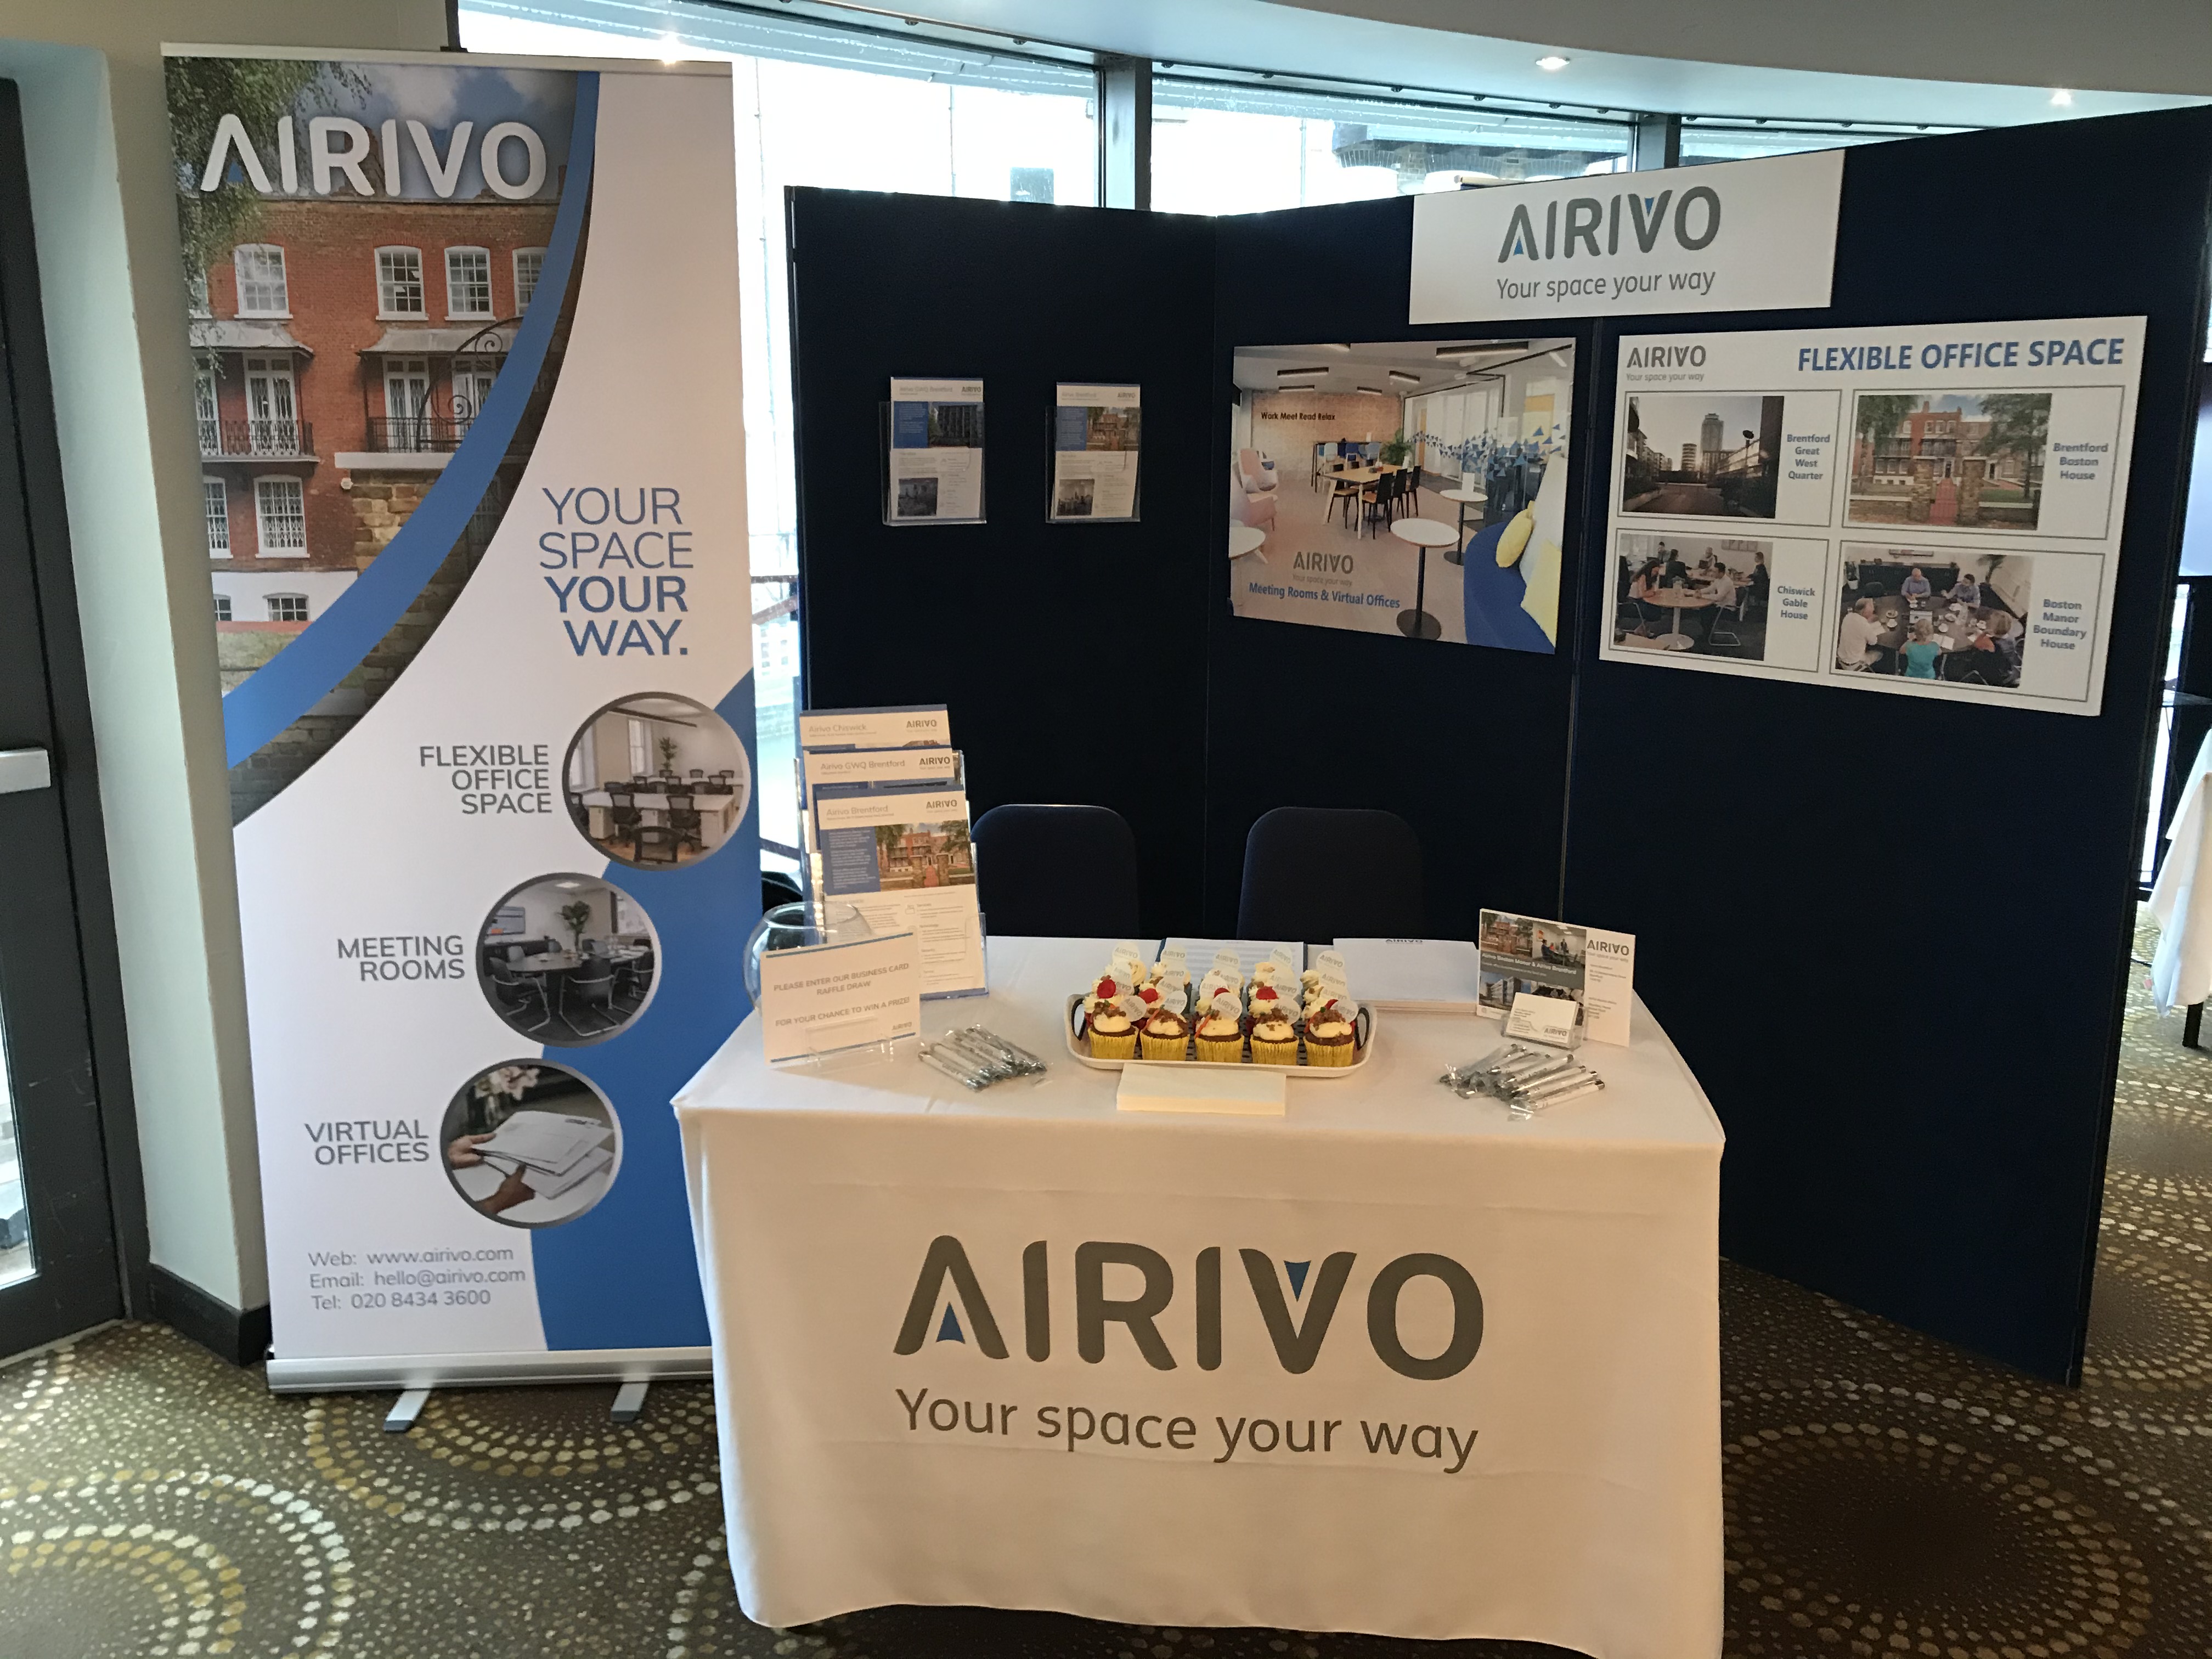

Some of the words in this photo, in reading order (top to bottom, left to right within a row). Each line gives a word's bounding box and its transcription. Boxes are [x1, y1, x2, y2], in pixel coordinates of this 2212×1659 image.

[200, 114, 547, 199] AIRIVO
[1498, 187, 1720, 263] AIRIVO
[1497, 278, 1539, 299] Your
[1547, 276, 1606, 302] space
[1612, 273, 1662, 300] your
[1669, 270, 1716, 296] way
[1627, 345, 1706, 368] AIRIVO
[1798, 345, 1912, 371] FLEXIBLE
[1921, 341, 2017, 368] OFFICE
[2027, 338, 2124, 366] SPACE
[1627, 373, 1642, 381] Your
[1645, 373, 1667, 382] space
[1668, 374, 1686, 382] your
[1688, 373, 1704, 382] way
[1280, 412, 1297, 420] Meet
[1787, 434, 1830, 443] Brentford
[1795, 447, 1820, 455] Great
[2053, 443, 2109, 452] Brentford
[1795, 459, 1818, 467] West
[2059, 456, 2099, 466] Boston
[1788, 471, 1824, 479] Quarter
[2060, 470, 2096, 480] House
[541, 487, 682, 525] YOUR
[539, 532, 693, 569] SPACE
[1293, 551, 1353, 574] AIRIVO
[1324, 578, 1339, 586] your
[544, 576, 688, 613] YOUR
[1249, 582, 1285, 599] Meeting
[1288, 586, 1318, 599] Rooms
[1321, 590, 1329, 601] &
[1332, 591, 1364, 605] Virtual
[1367, 594, 1401, 608] Offices
[1778, 585, 1815, 596] Chiswick
[1782, 598, 1808, 607] Gable
[2043, 599, 2082, 610] Boston
[1781, 610, 1808, 619] House
[2043, 612, 2080, 623] Manor
[563, 619, 688, 656] WAY.
[2033, 625, 2087, 640] Boundary
[2041, 639, 2075, 650] House
[809, 725, 831, 733] Airivo
[833, 724, 867, 732] Chiswick
[906, 719, 938, 729] AIRIVO
[420, 744, 549, 768] FLEXIBLE
[919, 757, 951, 765] AIRIVO
[821, 762, 843, 771] Airivo
[845, 761, 867, 770] GWQ
[868, 759, 905, 768] Brentford
[452, 768, 549, 791] OFFICE
[461, 792, 552, 815] SPACE
[826, 808, 849, 816] Airivo
[851, 805, 889, 814] Brentford
[926, 799, 957, 809] AIRIVO
[337, 935, 464, 959] MEETING
[1115, 946, 1139, 959] AIRIVO
[1163, 950, 1186, 958] AIRIVO
[1587, 939, 1629, 956] AIRIVO
[1216, 954, 1239, 965] AIRIVO
[1319, 954, 1343, 967] AIRIVO
[360, 958, 465, 981] ROOMS
[774, 982, 804, 991] PLEASE
[806, 978, 831, 988] ENTER
[833, 974, 850, 983] OUR
[851, 967, 887, 980] BUSINESS
[889, 963, 909, 972] CARD
[817, 984, 845, 995] RAFFLE
[847, 980, 871, 990] DRAW
[1274, 984, 1297, 994] AIRIVO
[775, 1018, 792, 1026] FOR
[793, 1014, 816, 1024] YOUR
[817, 1008, 849, 1020] CHANCE
[851, 1006, 862, 1014] TO
[864, 1003, 879, 1012] WIN
[888, 996, 910, 1007] PRIZE!
[1125, 998, 1143, 1017] AIRIVO
[1216, 997, 1240, 1014] AIRIVO
[1544, 1028, 1567, 1036] AIRIVO
[304, 1119, 429, 1143] VIRTUAL
[315, 1142, 430, 1165] OFFICES
[308, 1251, 357, 1266] Web:
[367, 1247, 514, 1264] www.airivo.com
[309, 1272, 364, 1289] Email:
[374, 1268, 526, 1288] hello@airivo.com
[311, 1294, 341, 1310] Tel:
[351, 1293, 386, 1309] 020
[392, 1291, 438, 1308] 8434
[443, 1289, 491, 1306] 3600
[893, 1234, 1485, 1381] AIRIVO
[895, 1387, 1018, 1436] Your
[1037, 1404, 1196, 1453] space
[1214, 1415, 1342, 1464] your
[1360, 1420, 1479, 1475] way
